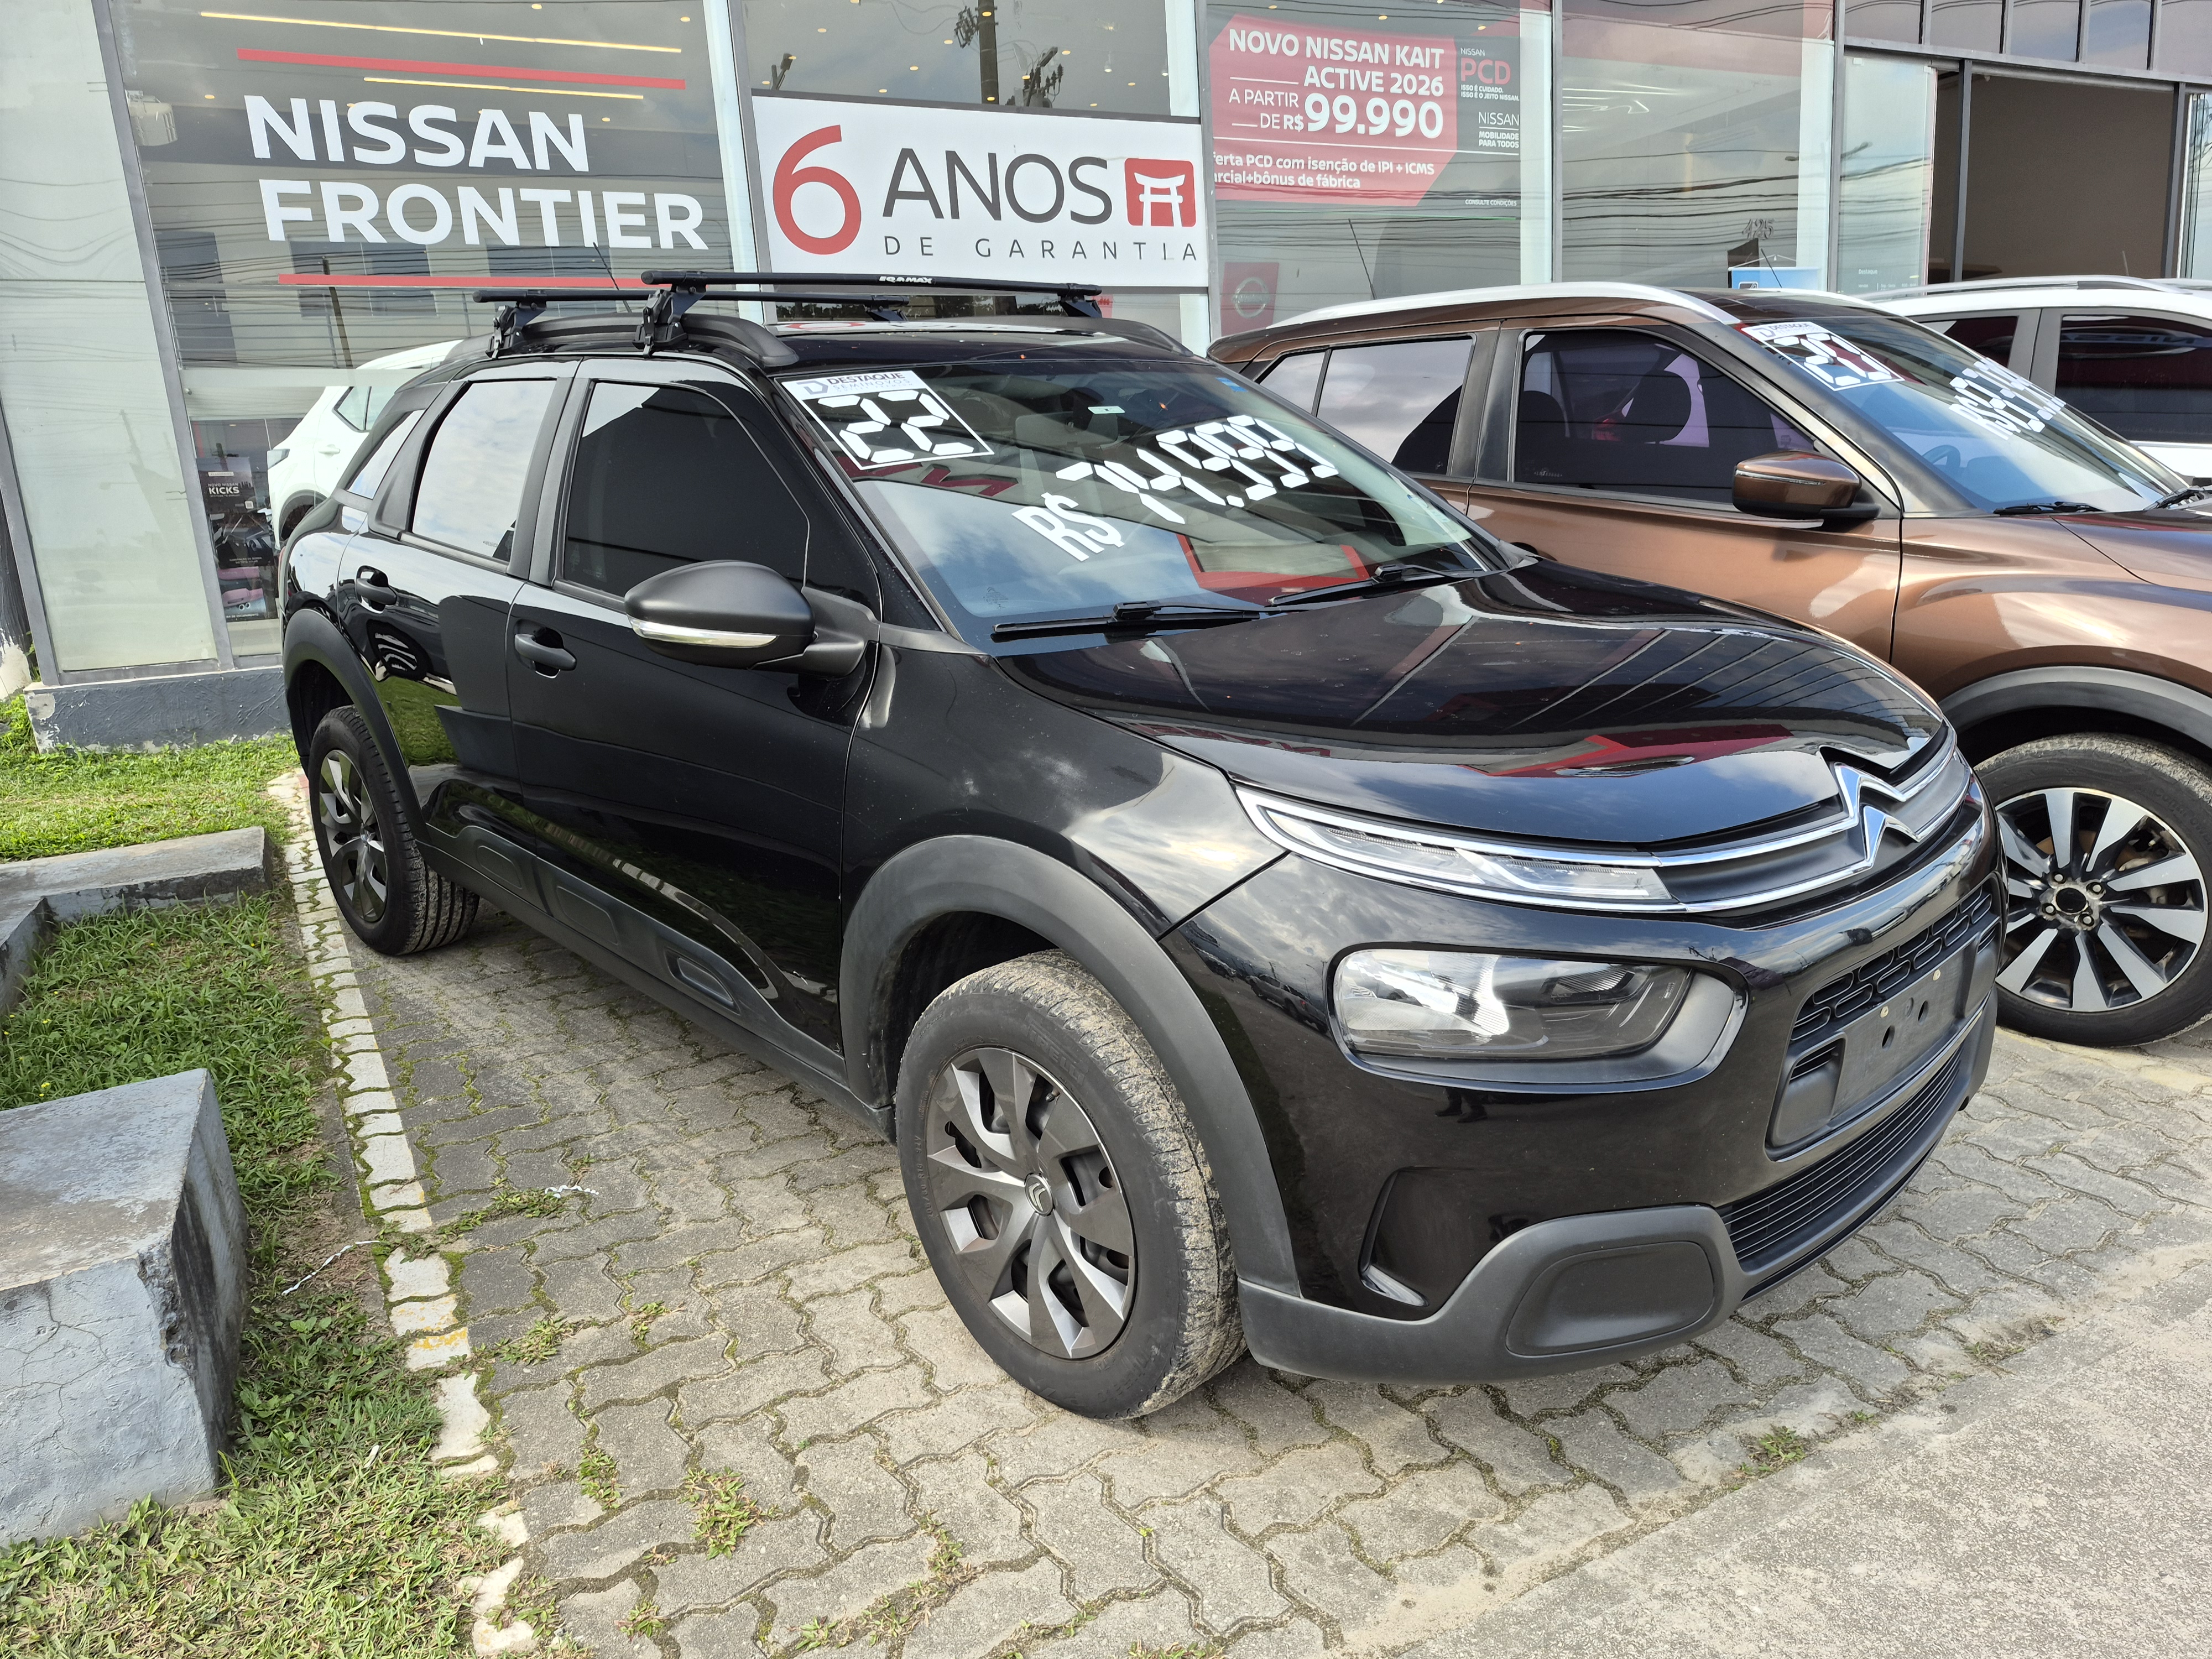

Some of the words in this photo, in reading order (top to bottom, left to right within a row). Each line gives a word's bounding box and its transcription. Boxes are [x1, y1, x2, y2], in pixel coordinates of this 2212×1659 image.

[1229, 28, 1299, 57] NOVO
[1306, 36, 1390, 64] NISSAN
[1395, 45, 1444, 69] KAIT
[1460, 48, 1485, 56] NISSAN
[1304, 66, 1383, 92] ACTIVE
[1390, 75, 1444, 96] 2026
[1460, 58, 1511, 85] PCD
[1229, 88, 1240, 104] A
[1244, 90, 1299, 108] PARTIR
[1260, 113, 1280, 129] DE
[1284, 114, 1304, 133] R$
[1305, 93, 1443, 139] 99.990
[1478, 112, 1519, 126] NISSAN
[244, 95, 589, 172] NISSAN
[1479, 131, 1520, 140] MOBILIDADE
[1497, 140, 1520, 148] TODOS
[1246, 154, 1273, 168] PCD
[1276, 158, 1304, 170] com
[1308, 156, 1357, 174] isenção
[1360, 160, 1375, 173] de
[1379, 161, 1393, 174] IPI
[1406, 162, 1434, 175] ICMS
[773, 124, 862, 255] 6
[882, 148, 1113, 225] ANOS
[1298, 174, 1314, 186] de
[1316, 174, 1360, 189] fábrica
[259, 179, 709, 251] FRONTIER
[1490, 199, 1517, 207] CONDIÇÕES
[885, 236, 933, 257] DE
[975, 238, 1197, 261] GARANTIA
[827, 373, 906, 385] DESTAQUE
[833, 379, 911, 390] SEMINOVOS
[816, 389, 975, 463] 22
[1949, 395, 2021, 441] R$
[1055, 415, 1339, 524] 74.999
[1011, 492, 1125, 562] R$
